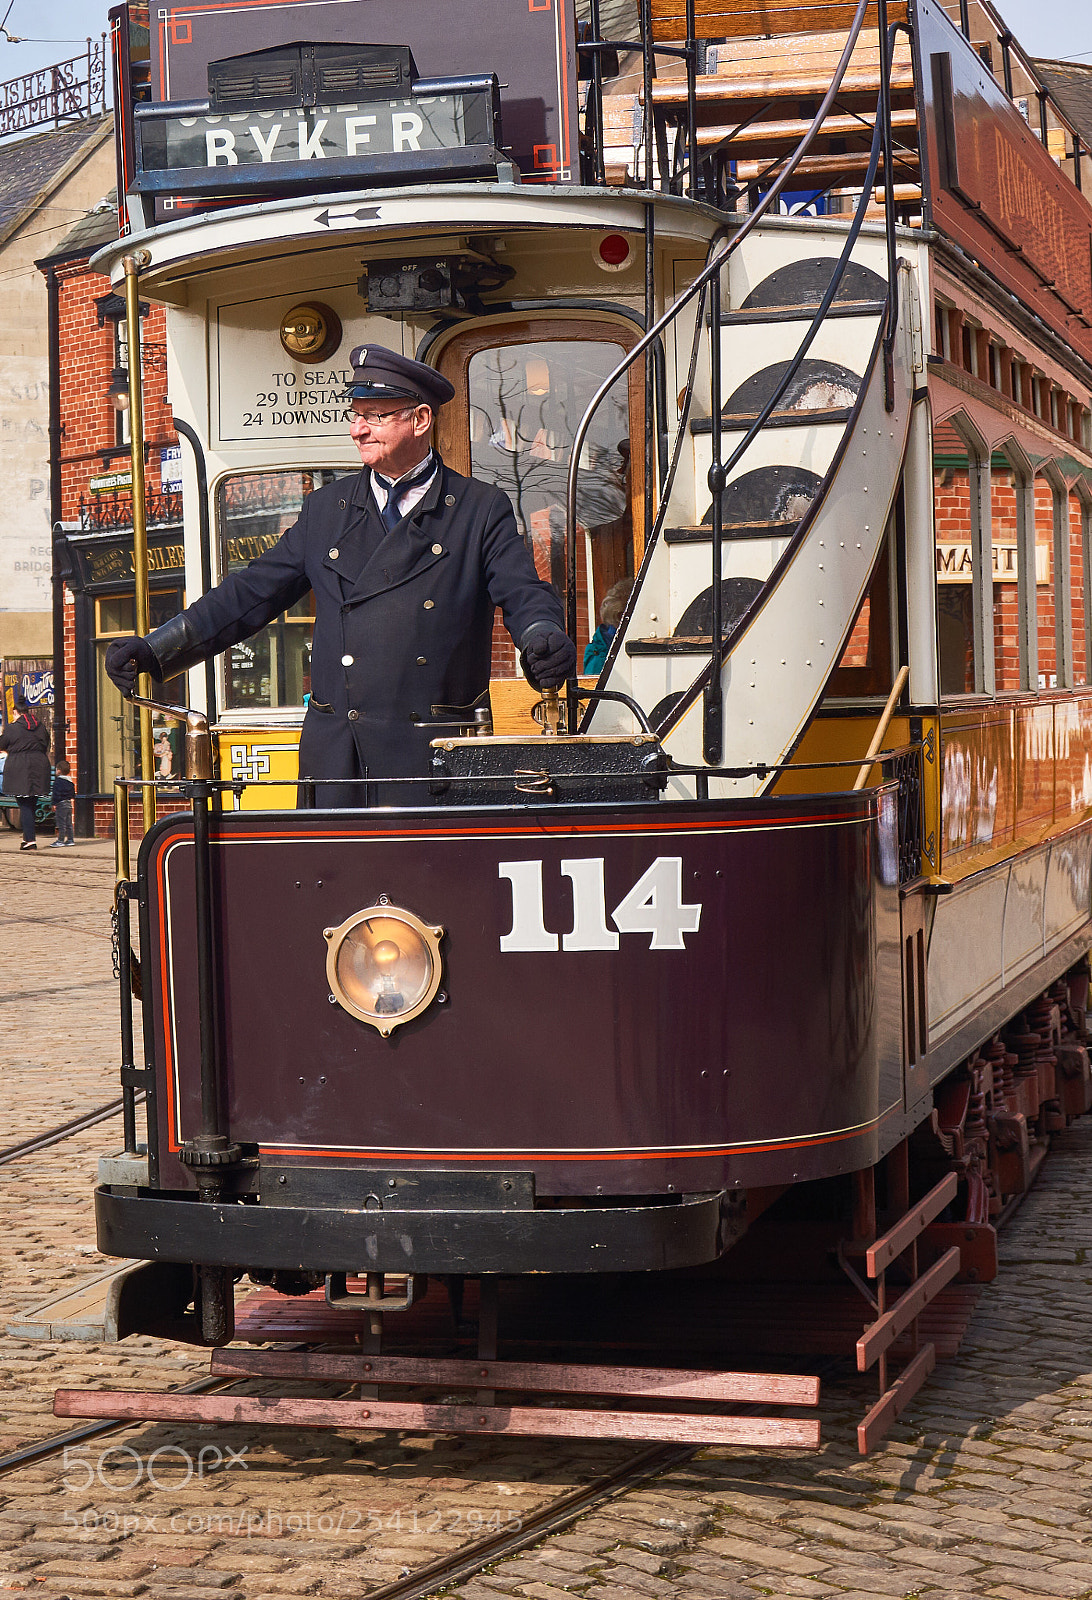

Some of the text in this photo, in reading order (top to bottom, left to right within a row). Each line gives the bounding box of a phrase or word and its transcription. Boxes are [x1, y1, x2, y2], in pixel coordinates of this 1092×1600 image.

[205, 112, 424, 167] BYKER
[272, 372, 296, 387] TO
[256, 391, 279, 407] 29
[242, 412, 263, 427] 24
[129, 545, 185, 573] JBILEE
[498, 856, 703, 952] 114
